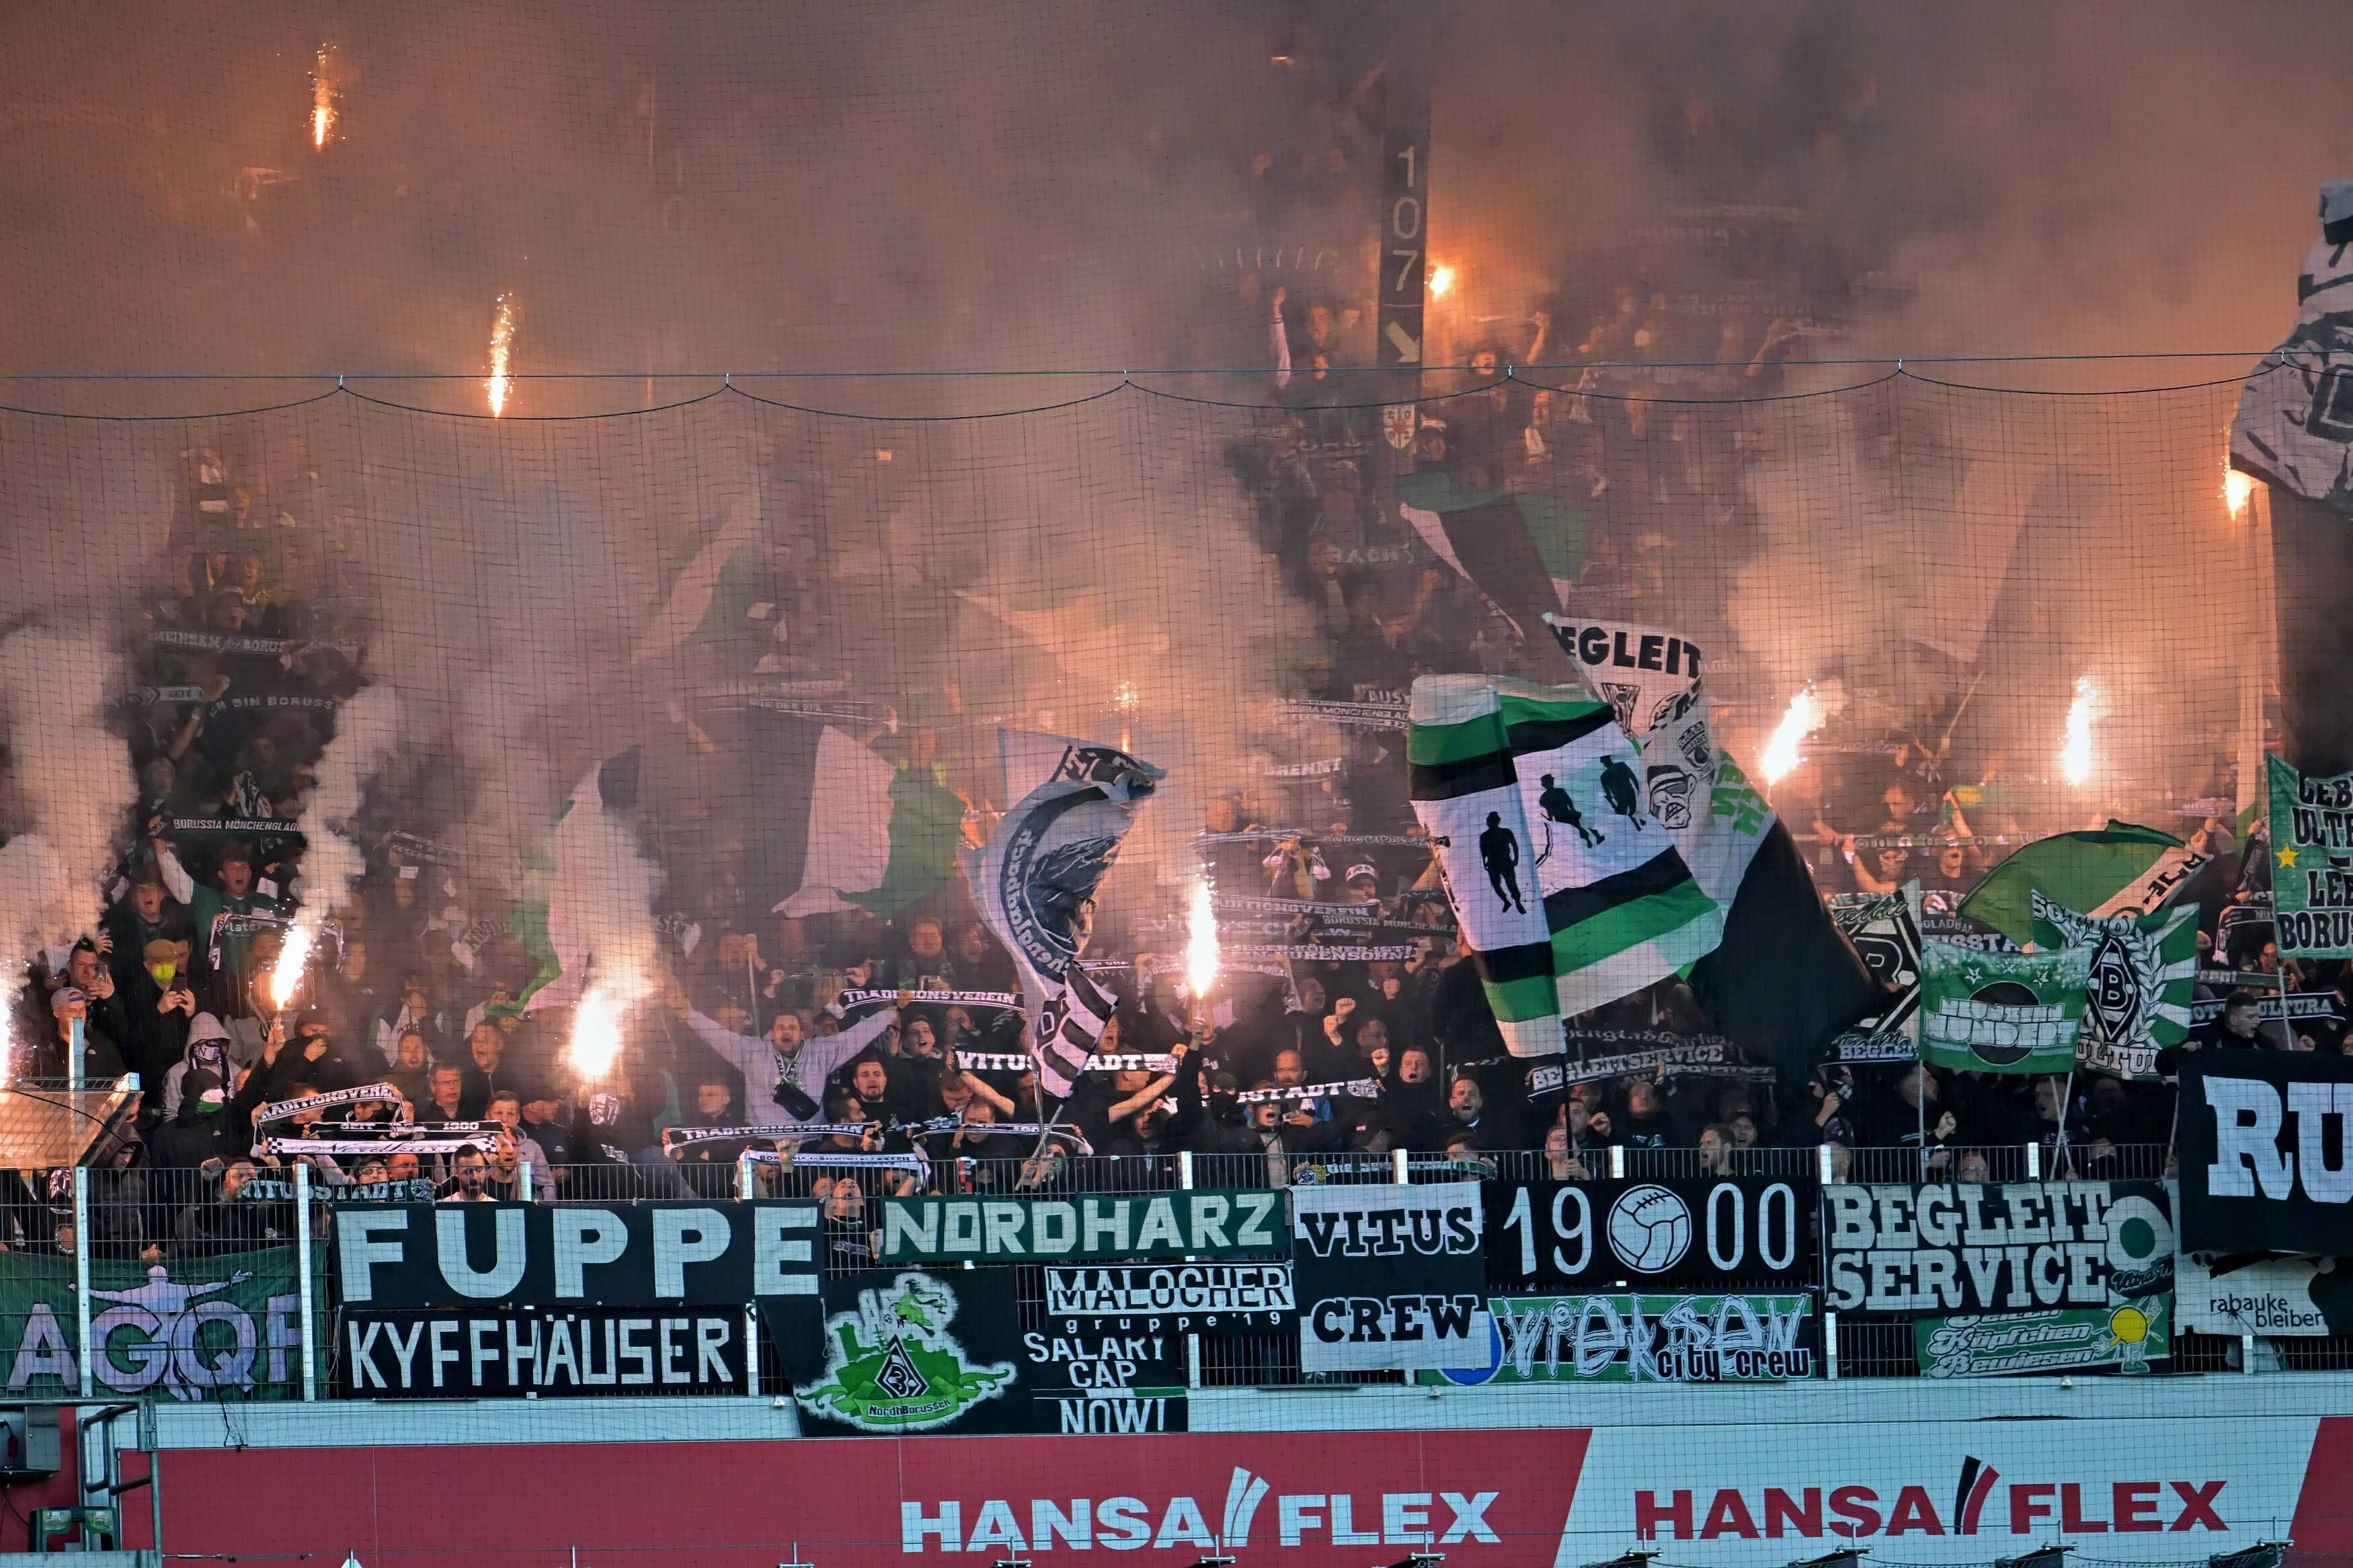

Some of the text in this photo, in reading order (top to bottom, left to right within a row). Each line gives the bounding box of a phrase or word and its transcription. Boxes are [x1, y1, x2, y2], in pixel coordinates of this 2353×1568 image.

[1392, 145, 1421, 292] 107
[232, 697, 260, 708] BIN
[2298, 773, 2353, 808] LEB
[173, 819, 222, 831] BORUSSIA
[2031, 893, 2130, 937] SOTTO
[2277, 911, 2353, 951] BORU
[1923, 1009, 2079, 1047] HUNDERT
[680, 1124, 863, 1141] TRADITIONSVEREIN
[885, 1193, 1276, 1255] NORDHARZ
[1299, 1206, 1479, 1257] VITUS
[1502, 1186, 1593, 1276] 19
[1825, 1181, 2113, 1251] BEGLEIT
[336, 1207, 820, 1302] FUPPE
[1052, 1266, 1291, 1312] MALOCHER
[1825, 1243, 2109, 1311] SERVICE
[1066, 1313, 1218, 1335] gruppe
[1310, 1294, 1478, 1343] CREW
[2210, 1293, 2288, 1312] rabauke
[348, 1314, 733, 1389] KYFFHÄUSER
[1023, 1331, 1165, 1363] SALARY
[1657, 1344, 1810, 1380] city crew
[1069, 1360, 1137, 1388] CAP
[1060, 1397, 1166, 1434] NOW!
[900, 1491, 1501, 1553] HANSA FLEX
[1634, 1481, 2229, 1540] HANSA FLEX
